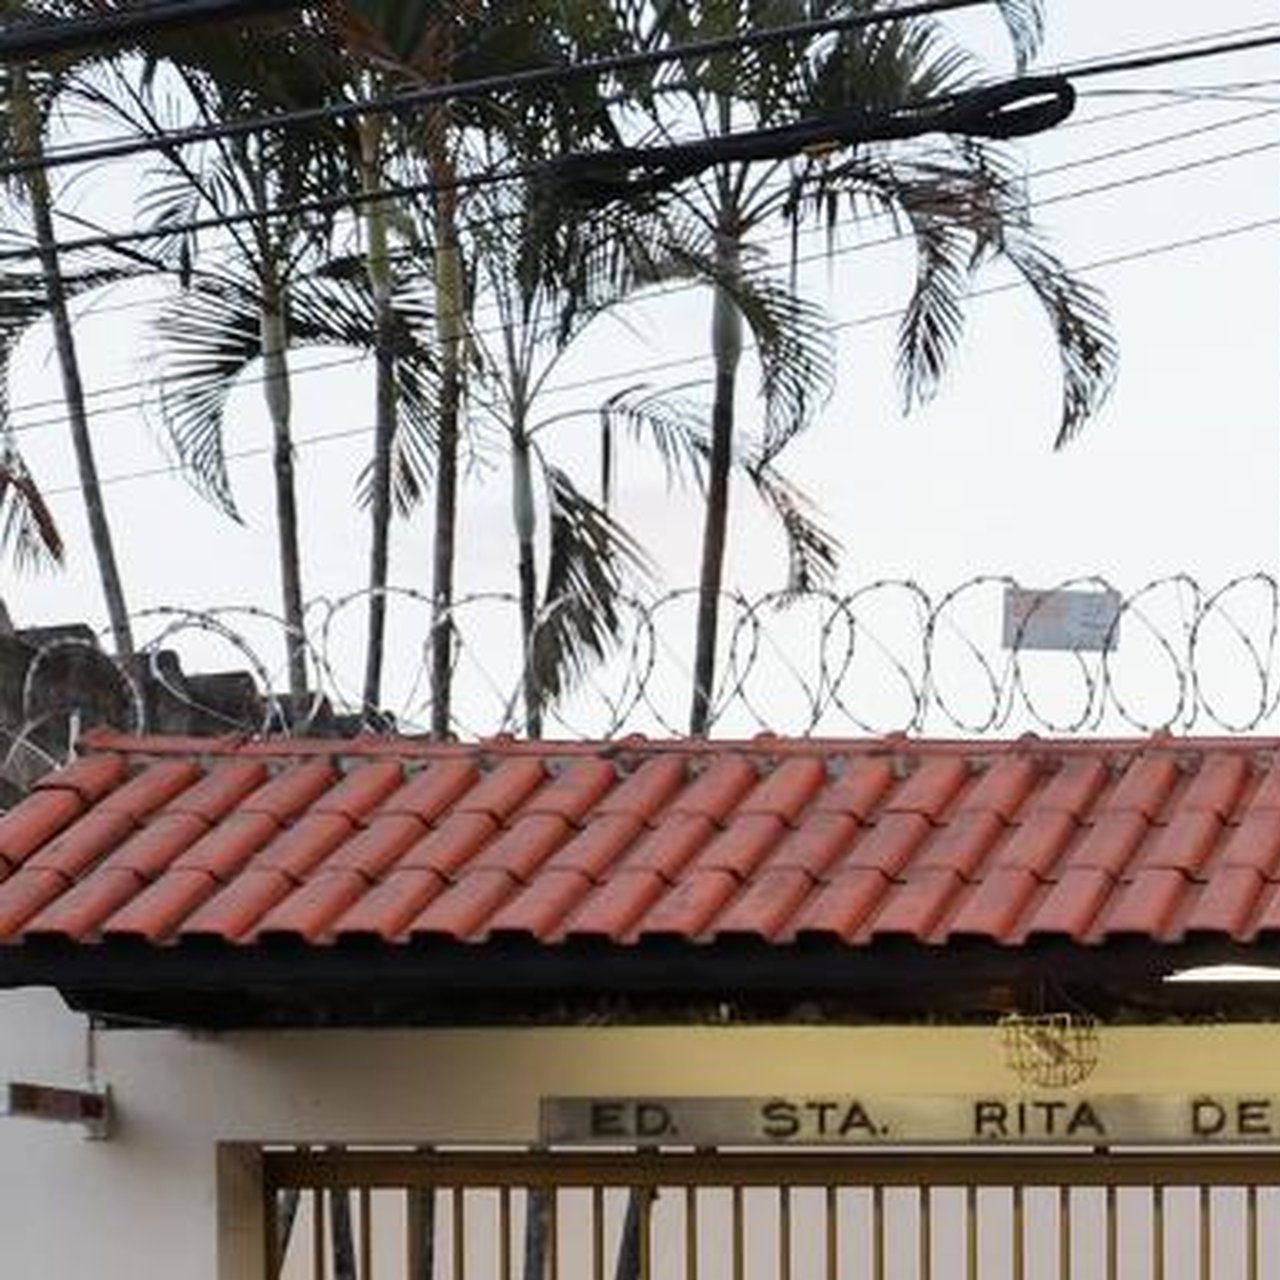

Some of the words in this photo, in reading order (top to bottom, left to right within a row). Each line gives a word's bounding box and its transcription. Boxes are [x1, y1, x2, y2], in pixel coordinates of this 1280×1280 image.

[591, 1103, 678, 1137] ED.
[761, 1100, 889, 1137] STA.
[974, 1101, 1106, 1136] RITA
[1191, 1099, 1272, 1136] DE
